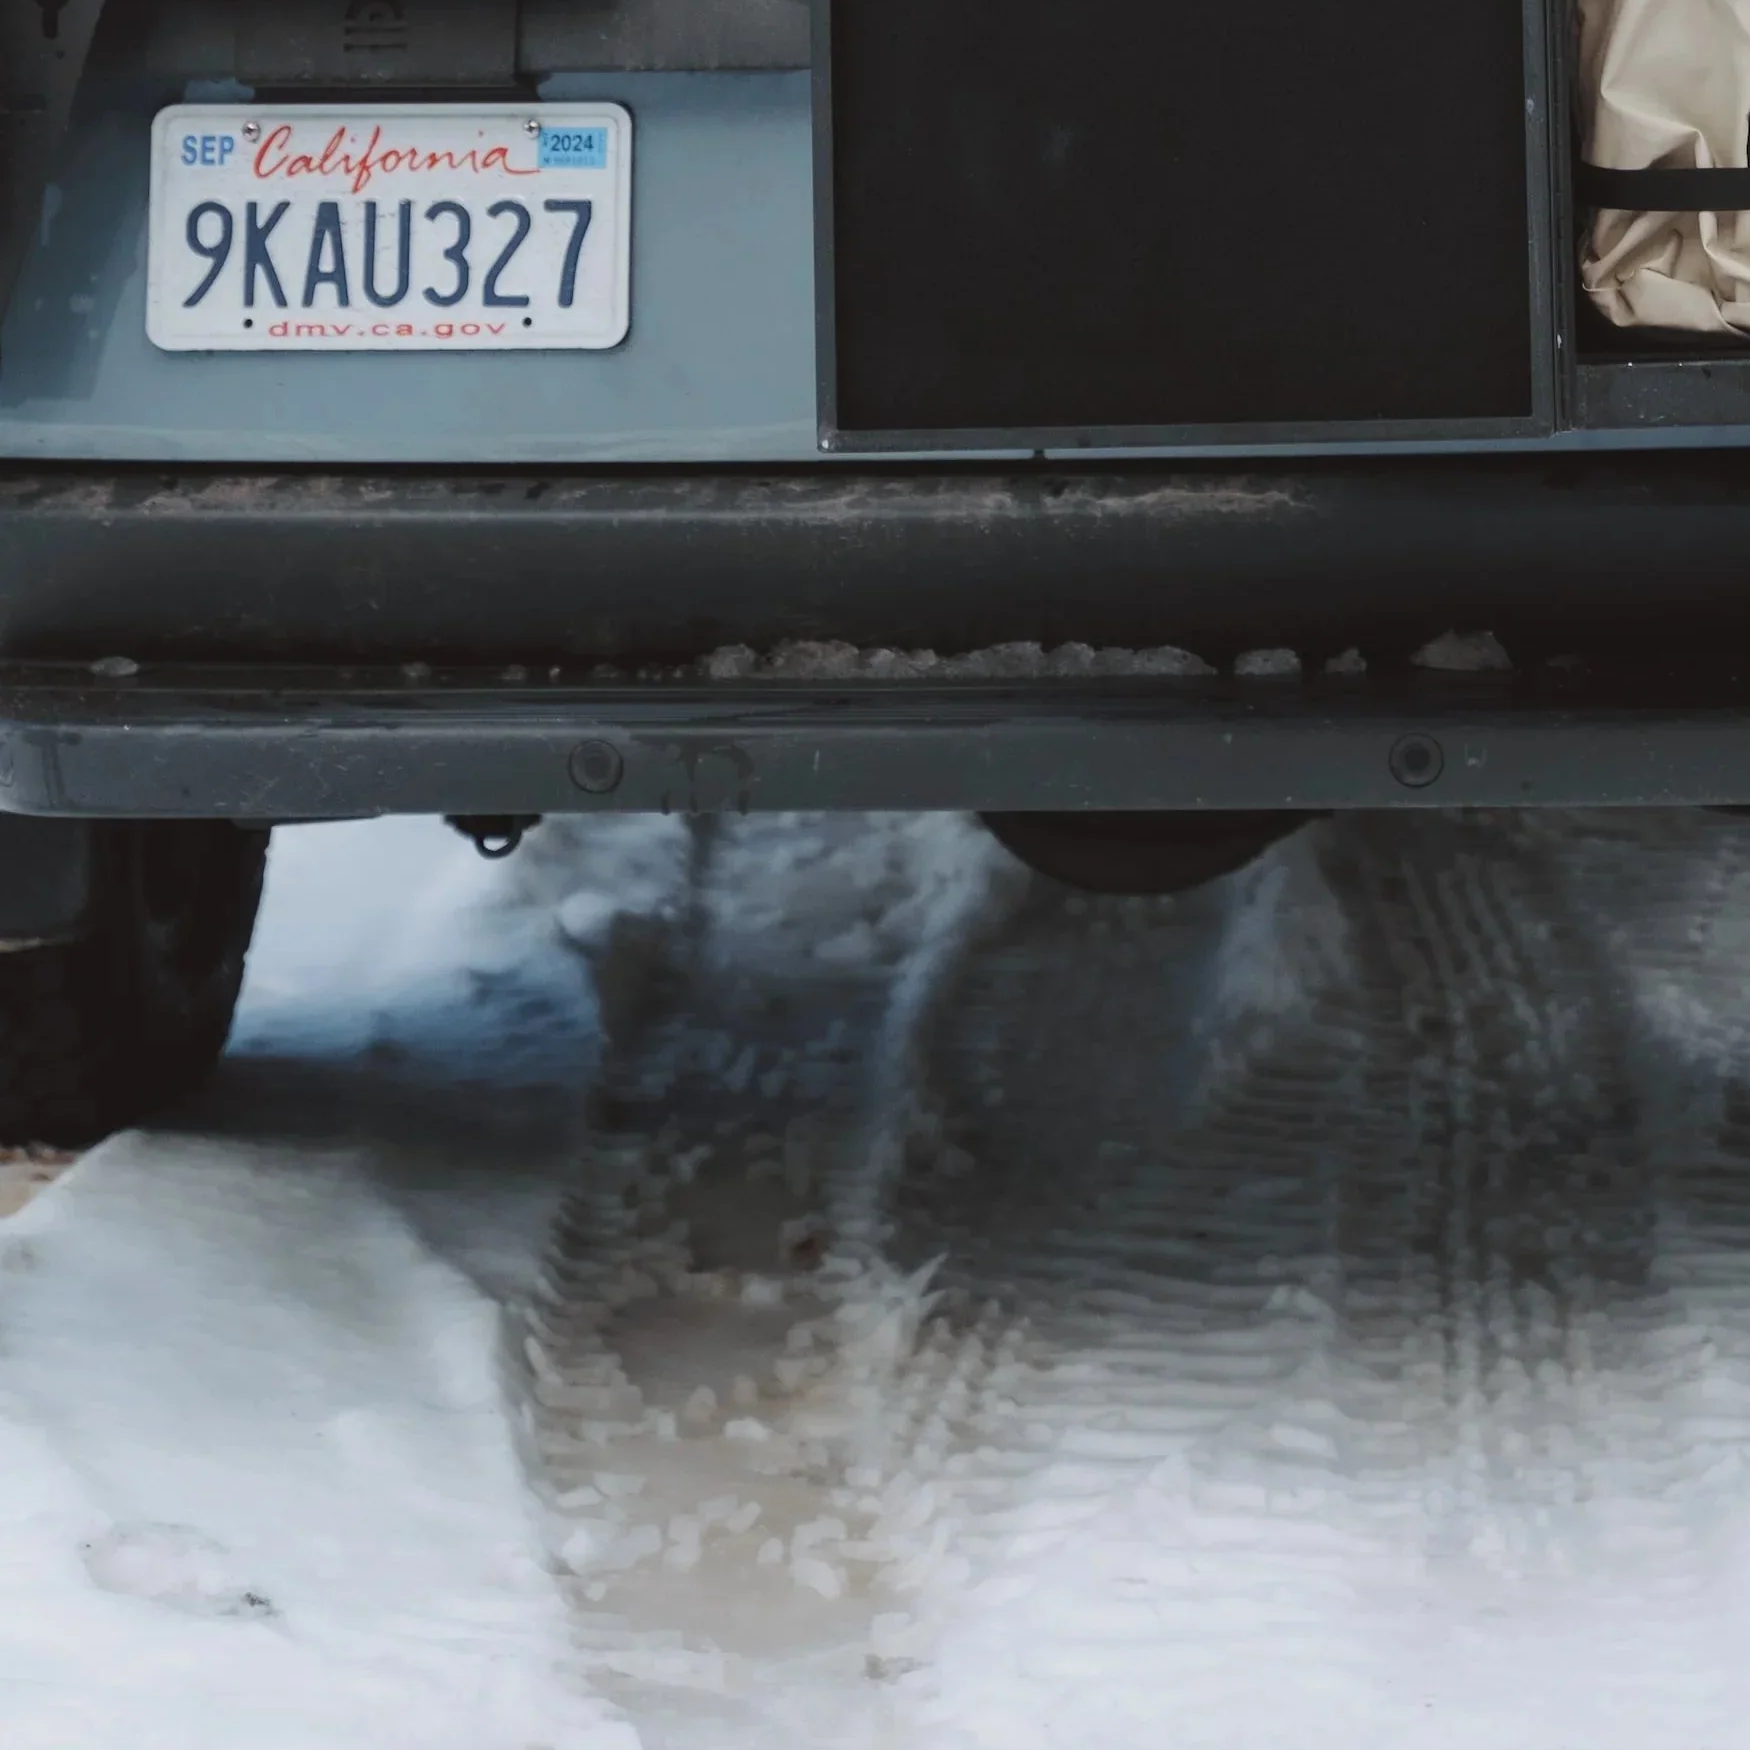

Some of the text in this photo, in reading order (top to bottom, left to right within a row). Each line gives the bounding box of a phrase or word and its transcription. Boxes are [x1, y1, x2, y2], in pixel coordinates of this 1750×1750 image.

[181, 135, 235, 166] SEP
[550, 134, 594, 153] 2024
[252, 125, 541, 194] California
[182, 200, 593, 309] 9KAU327
[268, 320, 506, 338] dmv.ca.gov
